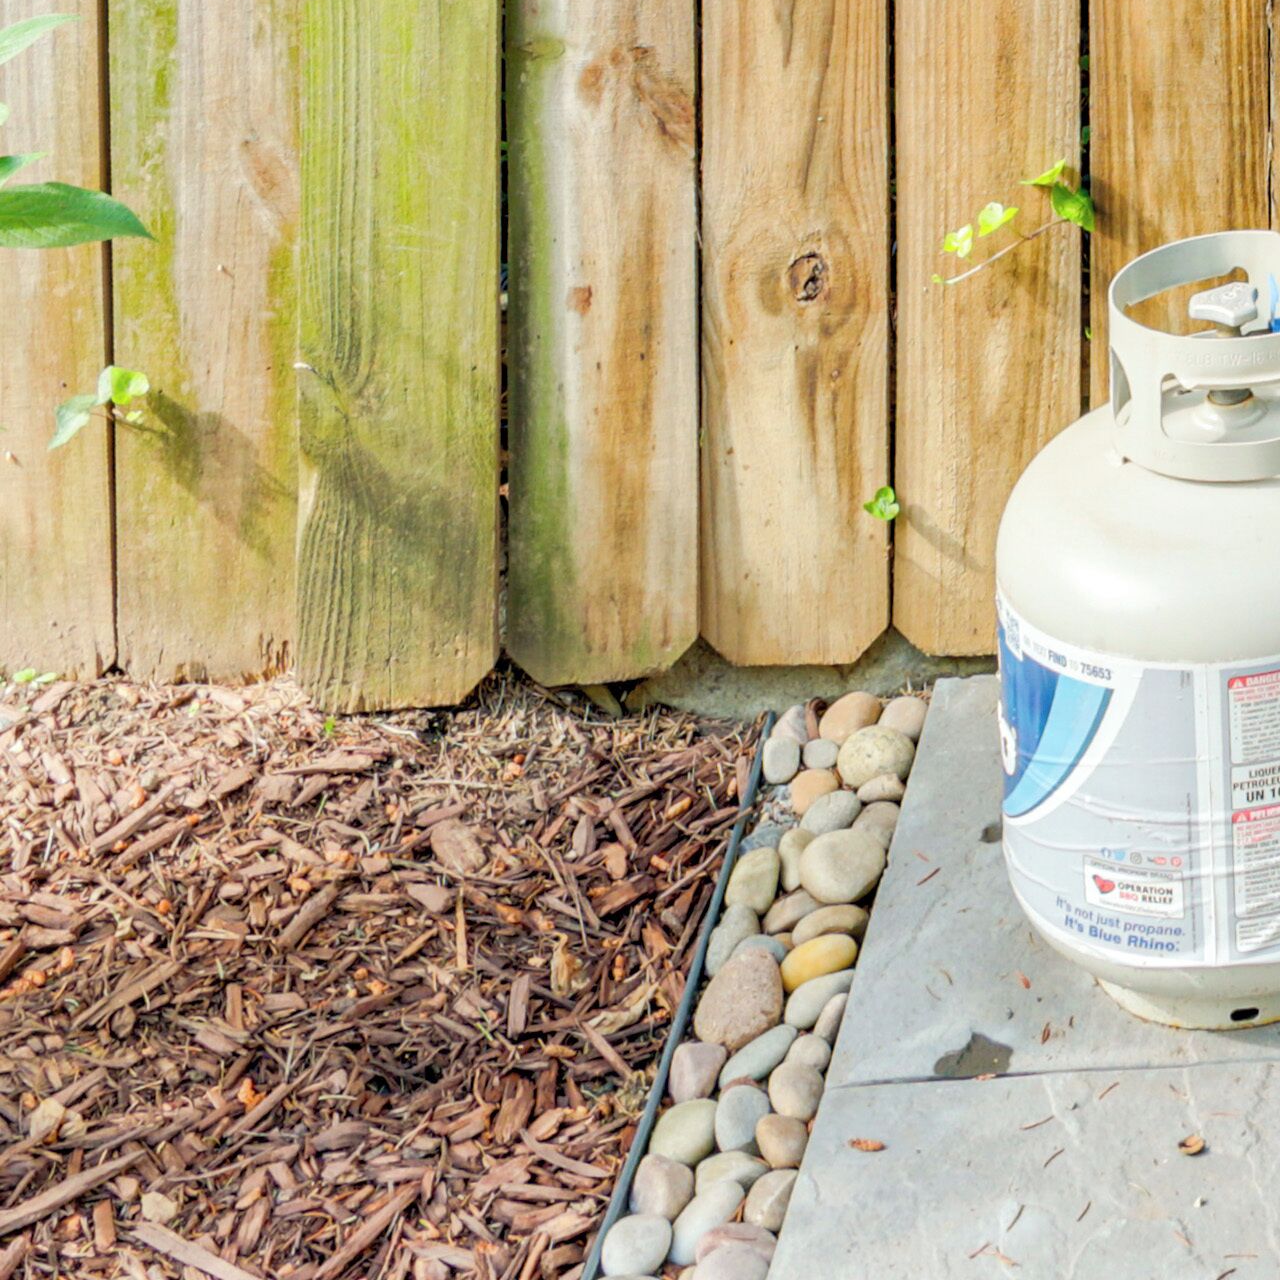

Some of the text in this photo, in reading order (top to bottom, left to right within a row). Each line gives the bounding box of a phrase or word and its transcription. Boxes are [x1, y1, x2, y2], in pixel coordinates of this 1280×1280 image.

[1048, 649, 1067, 668] FIND
[1080, 662, 1112, 681] 75653
[1246, 789, 1265, 803] UN
[1118, 882, 1173, 895] OPERATION
[1141, 895, 1173, 905] RELIEF
[1056, 895, 1072, 912] It's
[1075, 907, 1093, 921] not
[1096, 913, 1120, 928] just
[1123, 921, 1186, 936] propane.
[1065, 915, 1084, 932] It's
[1088, 925, 1122, 944] Blue
